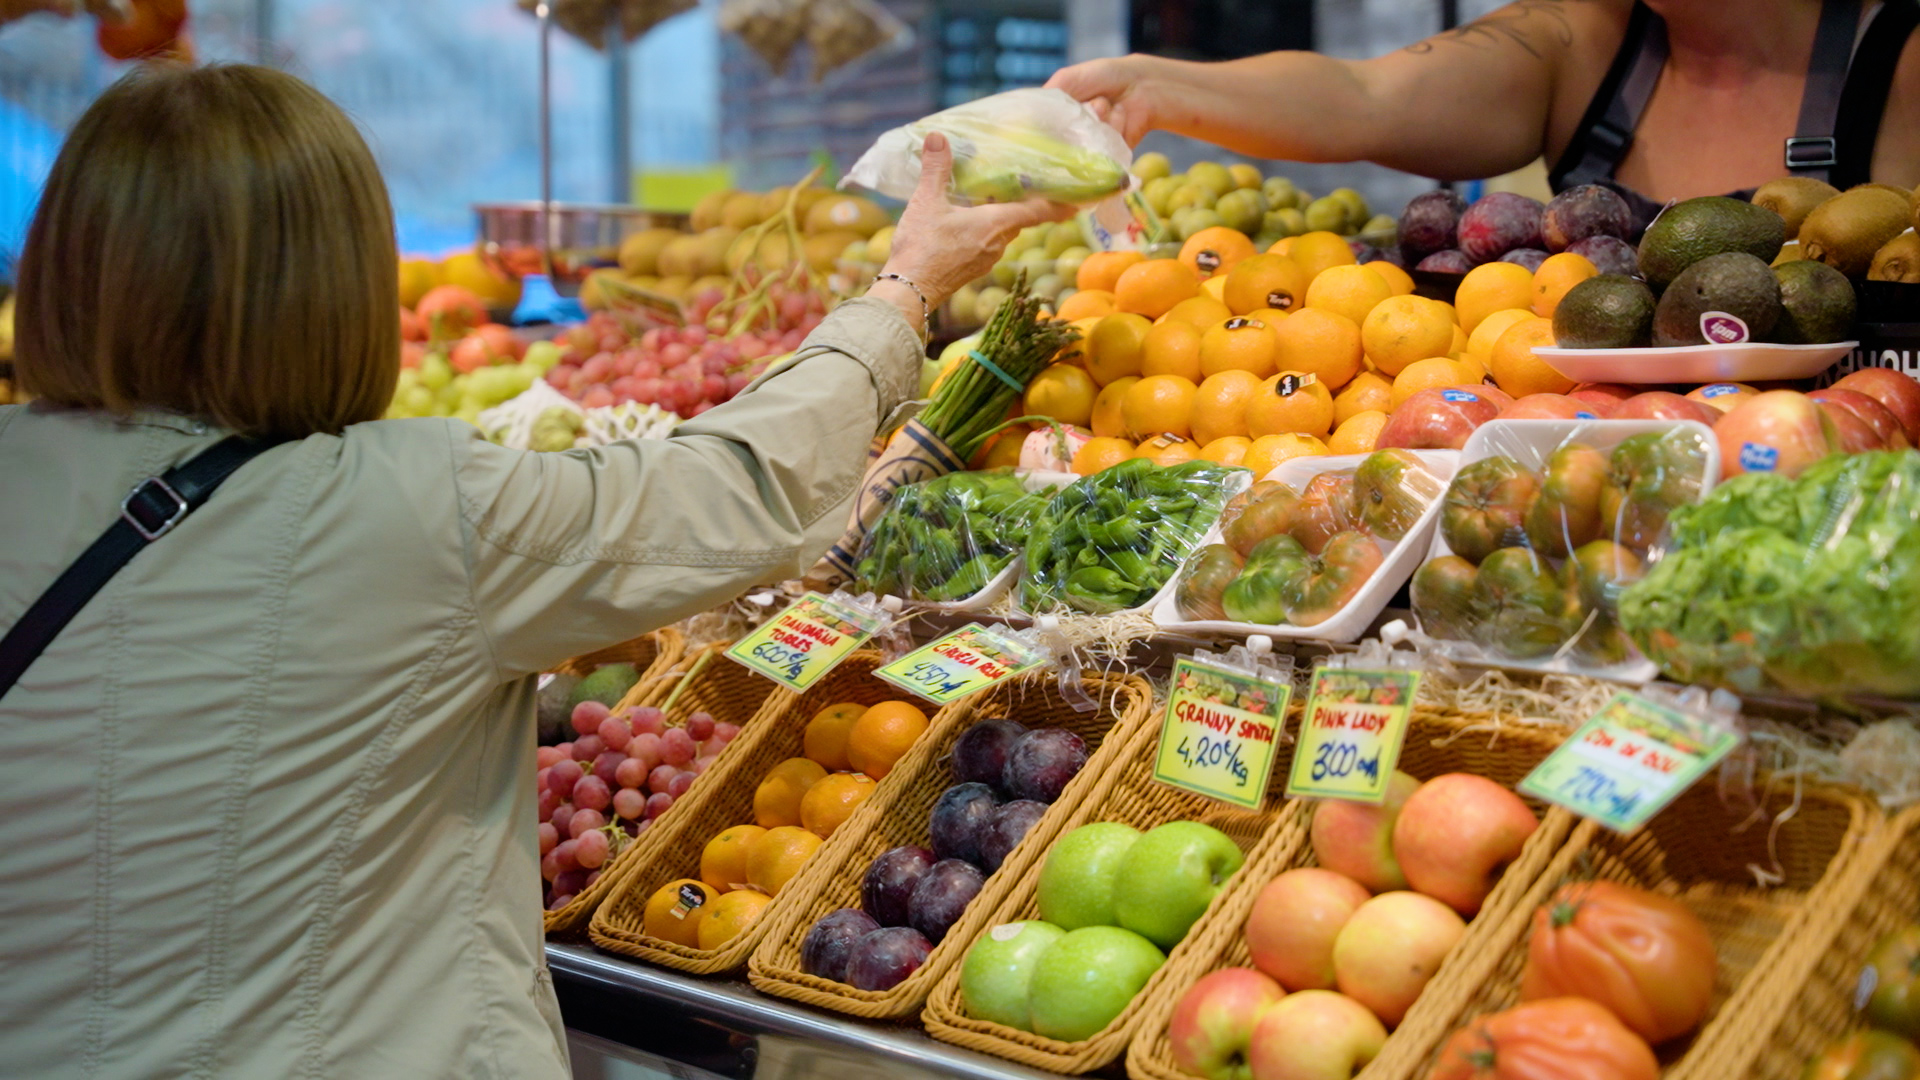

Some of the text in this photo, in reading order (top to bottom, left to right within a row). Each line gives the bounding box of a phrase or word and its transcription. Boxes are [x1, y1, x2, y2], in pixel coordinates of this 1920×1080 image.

[768, 628, 813, 653] TORRES
[932, 643, 979, 667] CIRUELA
[1175, 700, 1275, 746] GRANNY SMITH
[1312, 707, 1391, 736] PINK LADY
